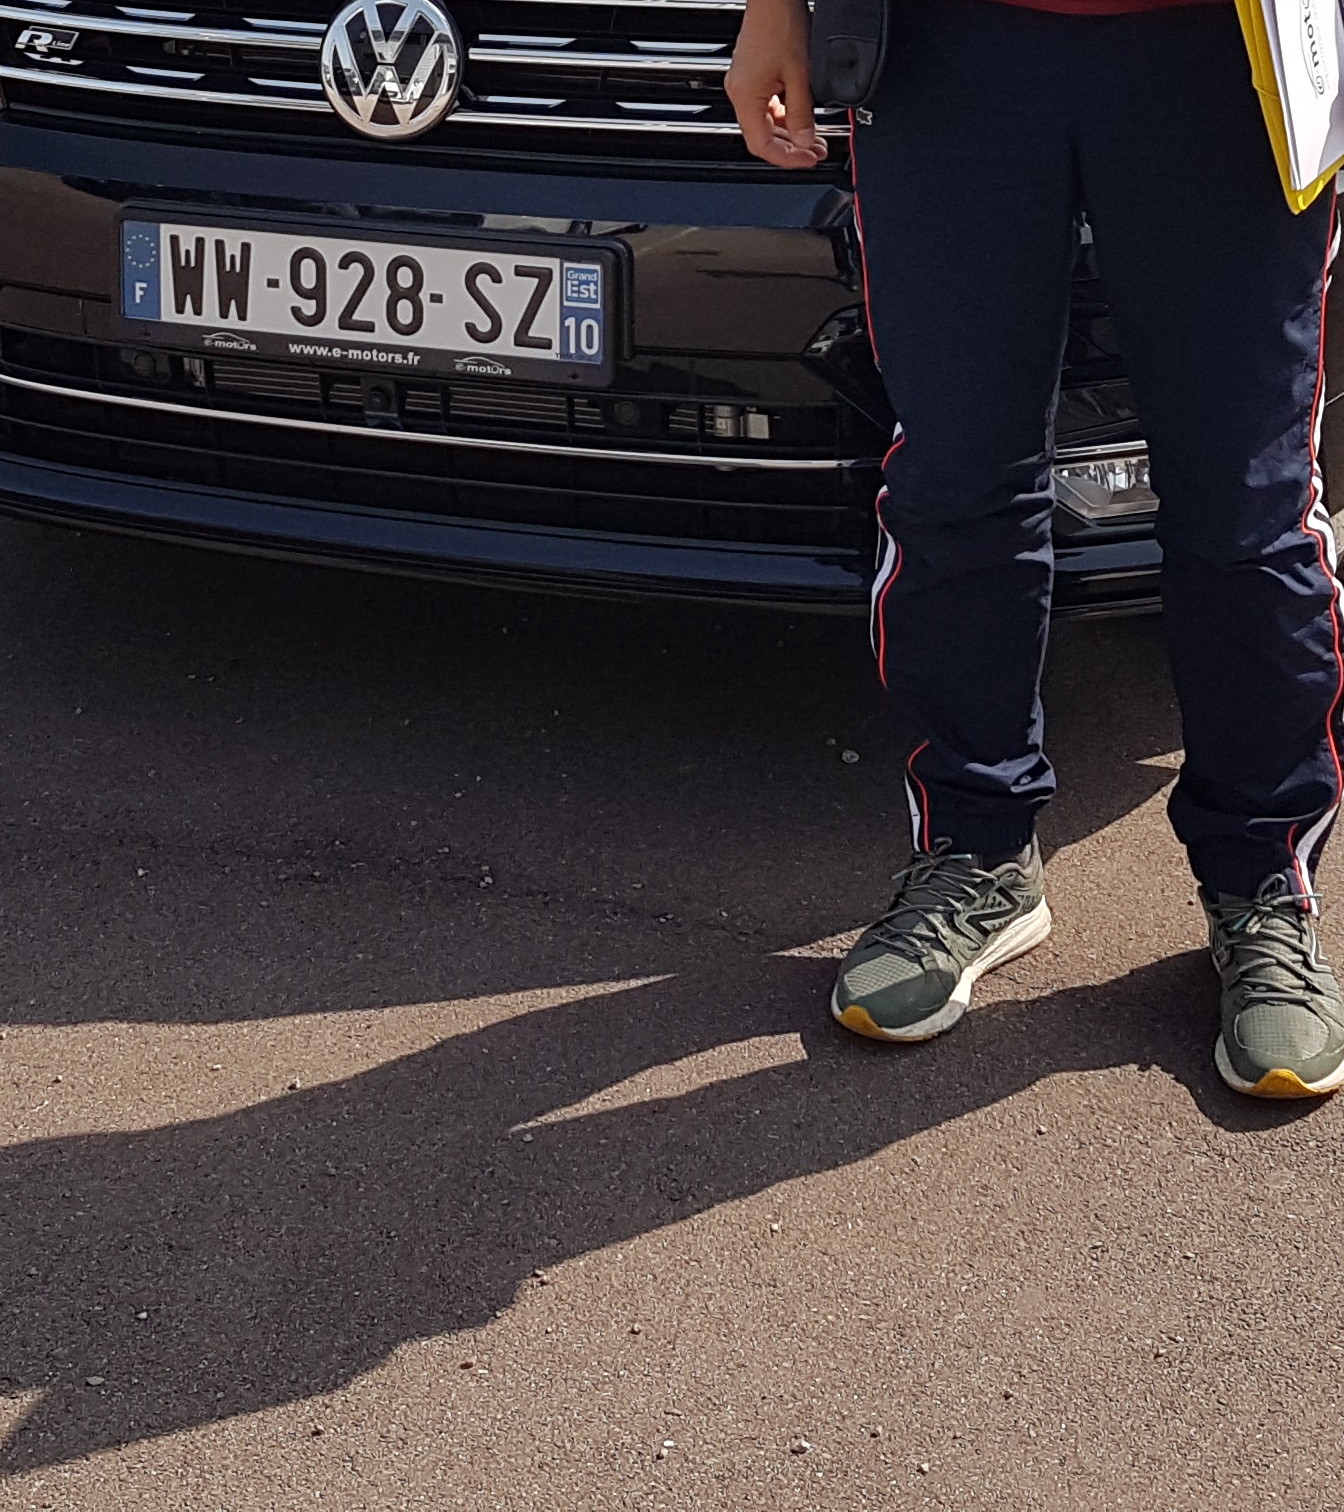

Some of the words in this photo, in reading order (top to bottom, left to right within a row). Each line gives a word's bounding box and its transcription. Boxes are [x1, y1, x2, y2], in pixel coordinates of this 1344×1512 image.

[567, 270, 598, 282] Grand
[134, 282, 148, 304] F
[566, 280, 597, 299] Est
[564, 316, 600, 356] 10
[288, 341, 421, 366] www.e-motors.fr
